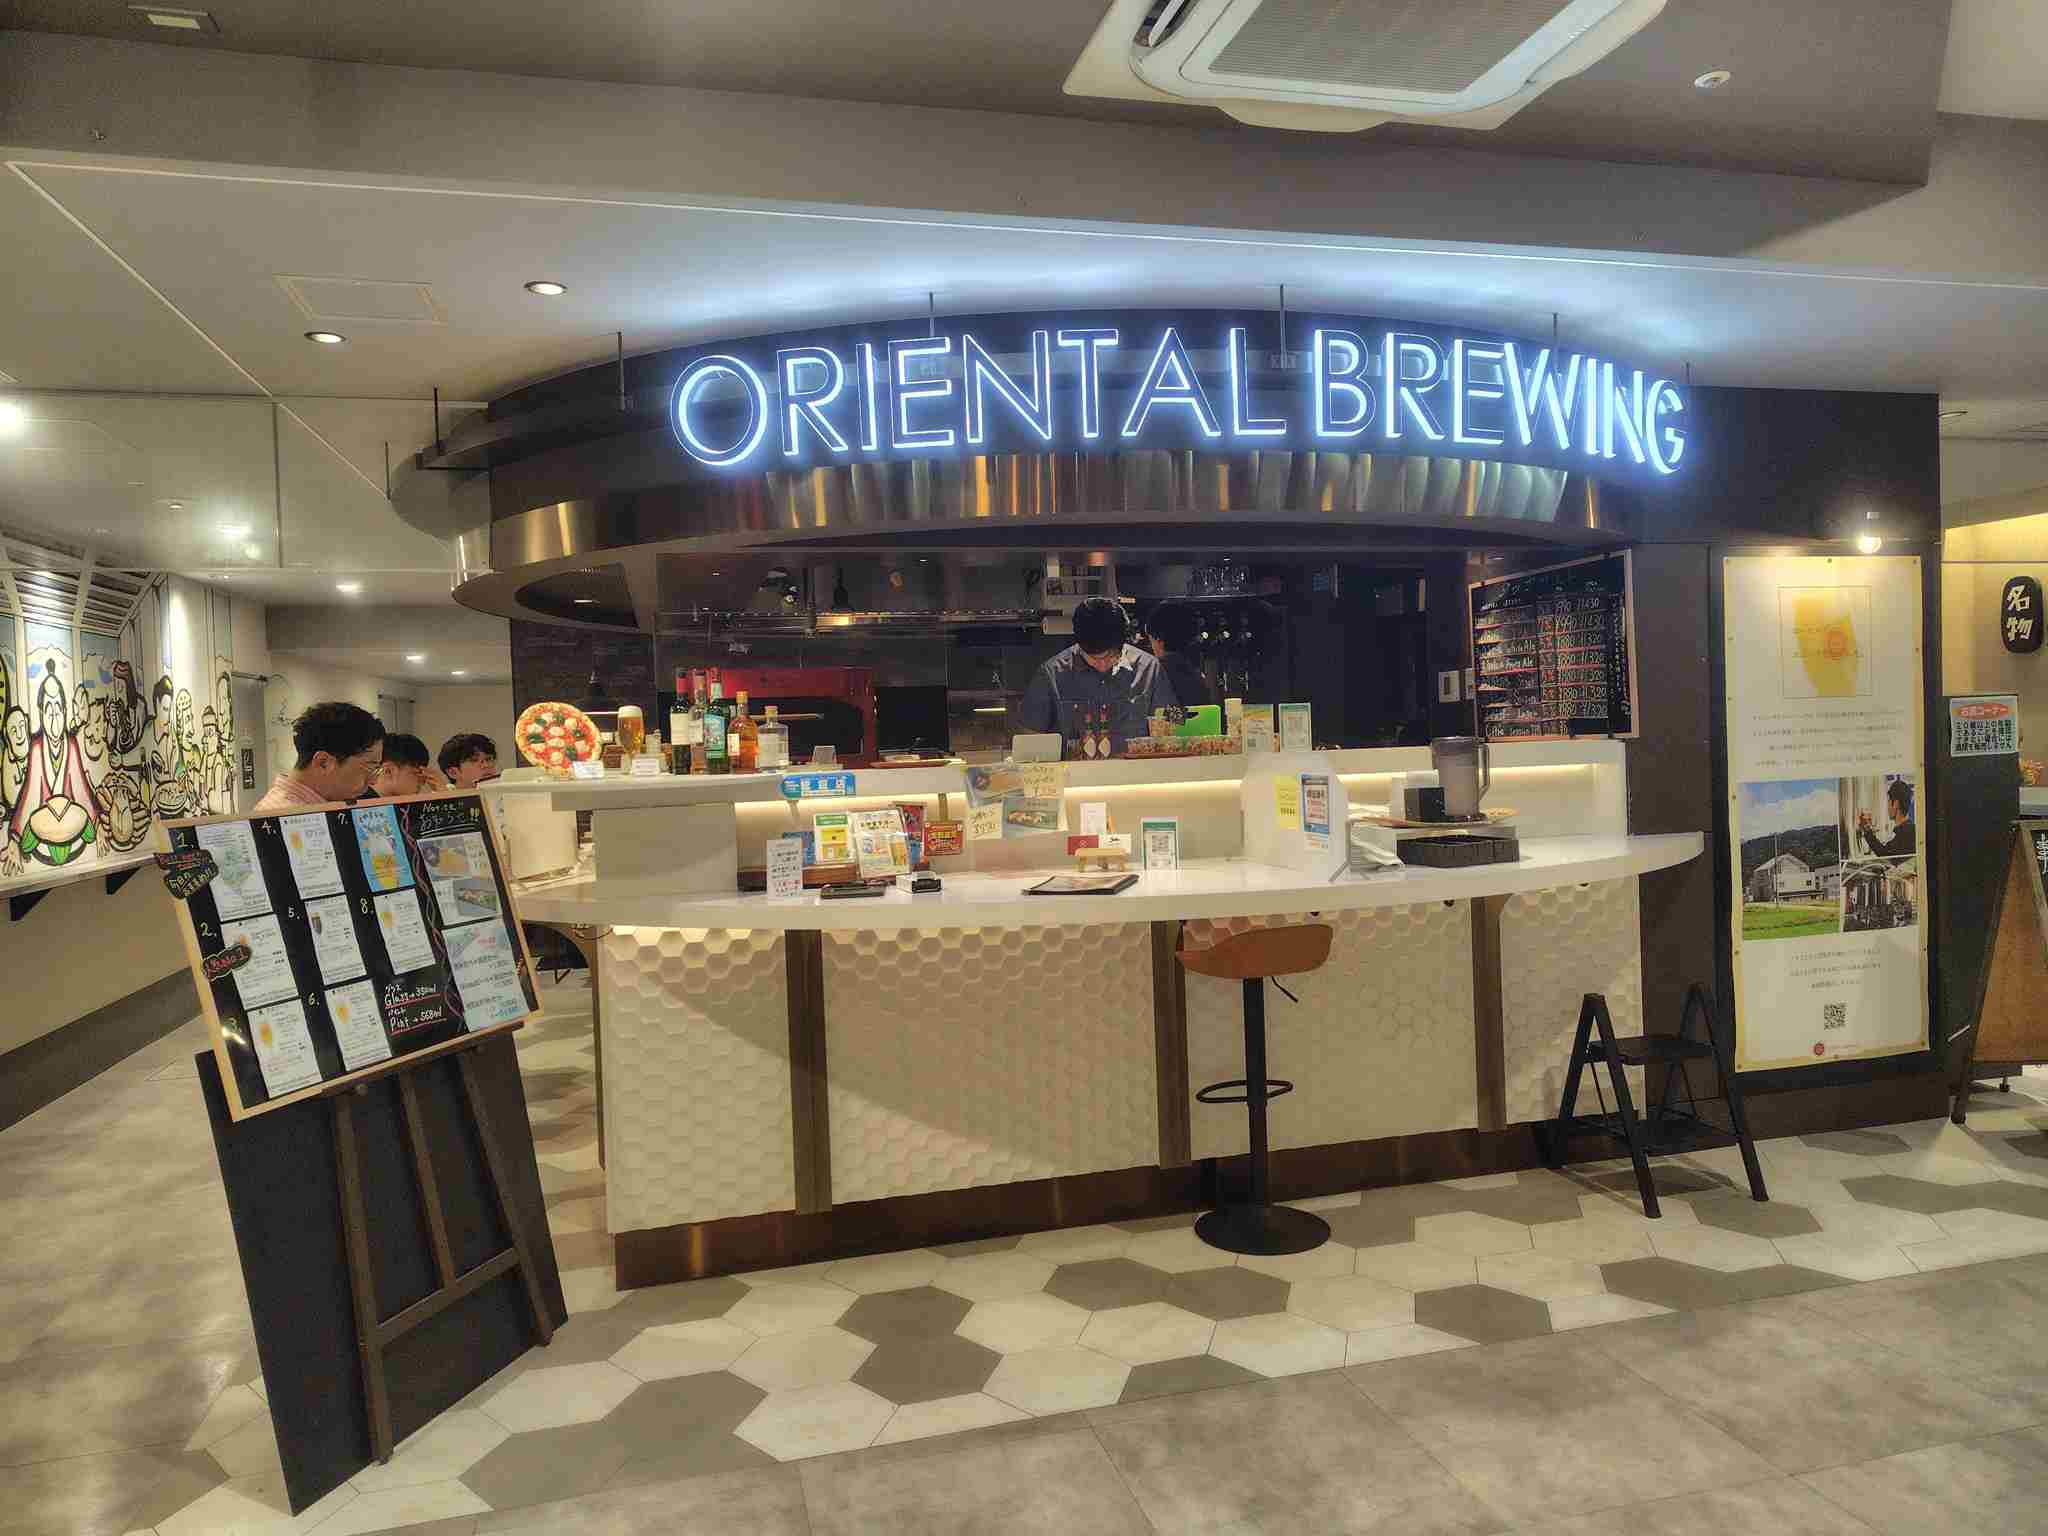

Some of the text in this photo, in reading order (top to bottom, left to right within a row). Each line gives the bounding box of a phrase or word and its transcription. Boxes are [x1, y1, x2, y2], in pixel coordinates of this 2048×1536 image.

[670, 326, 1685, 475] ORIENTAL BREWING
[2007, 584, 2033, 641] 名物
